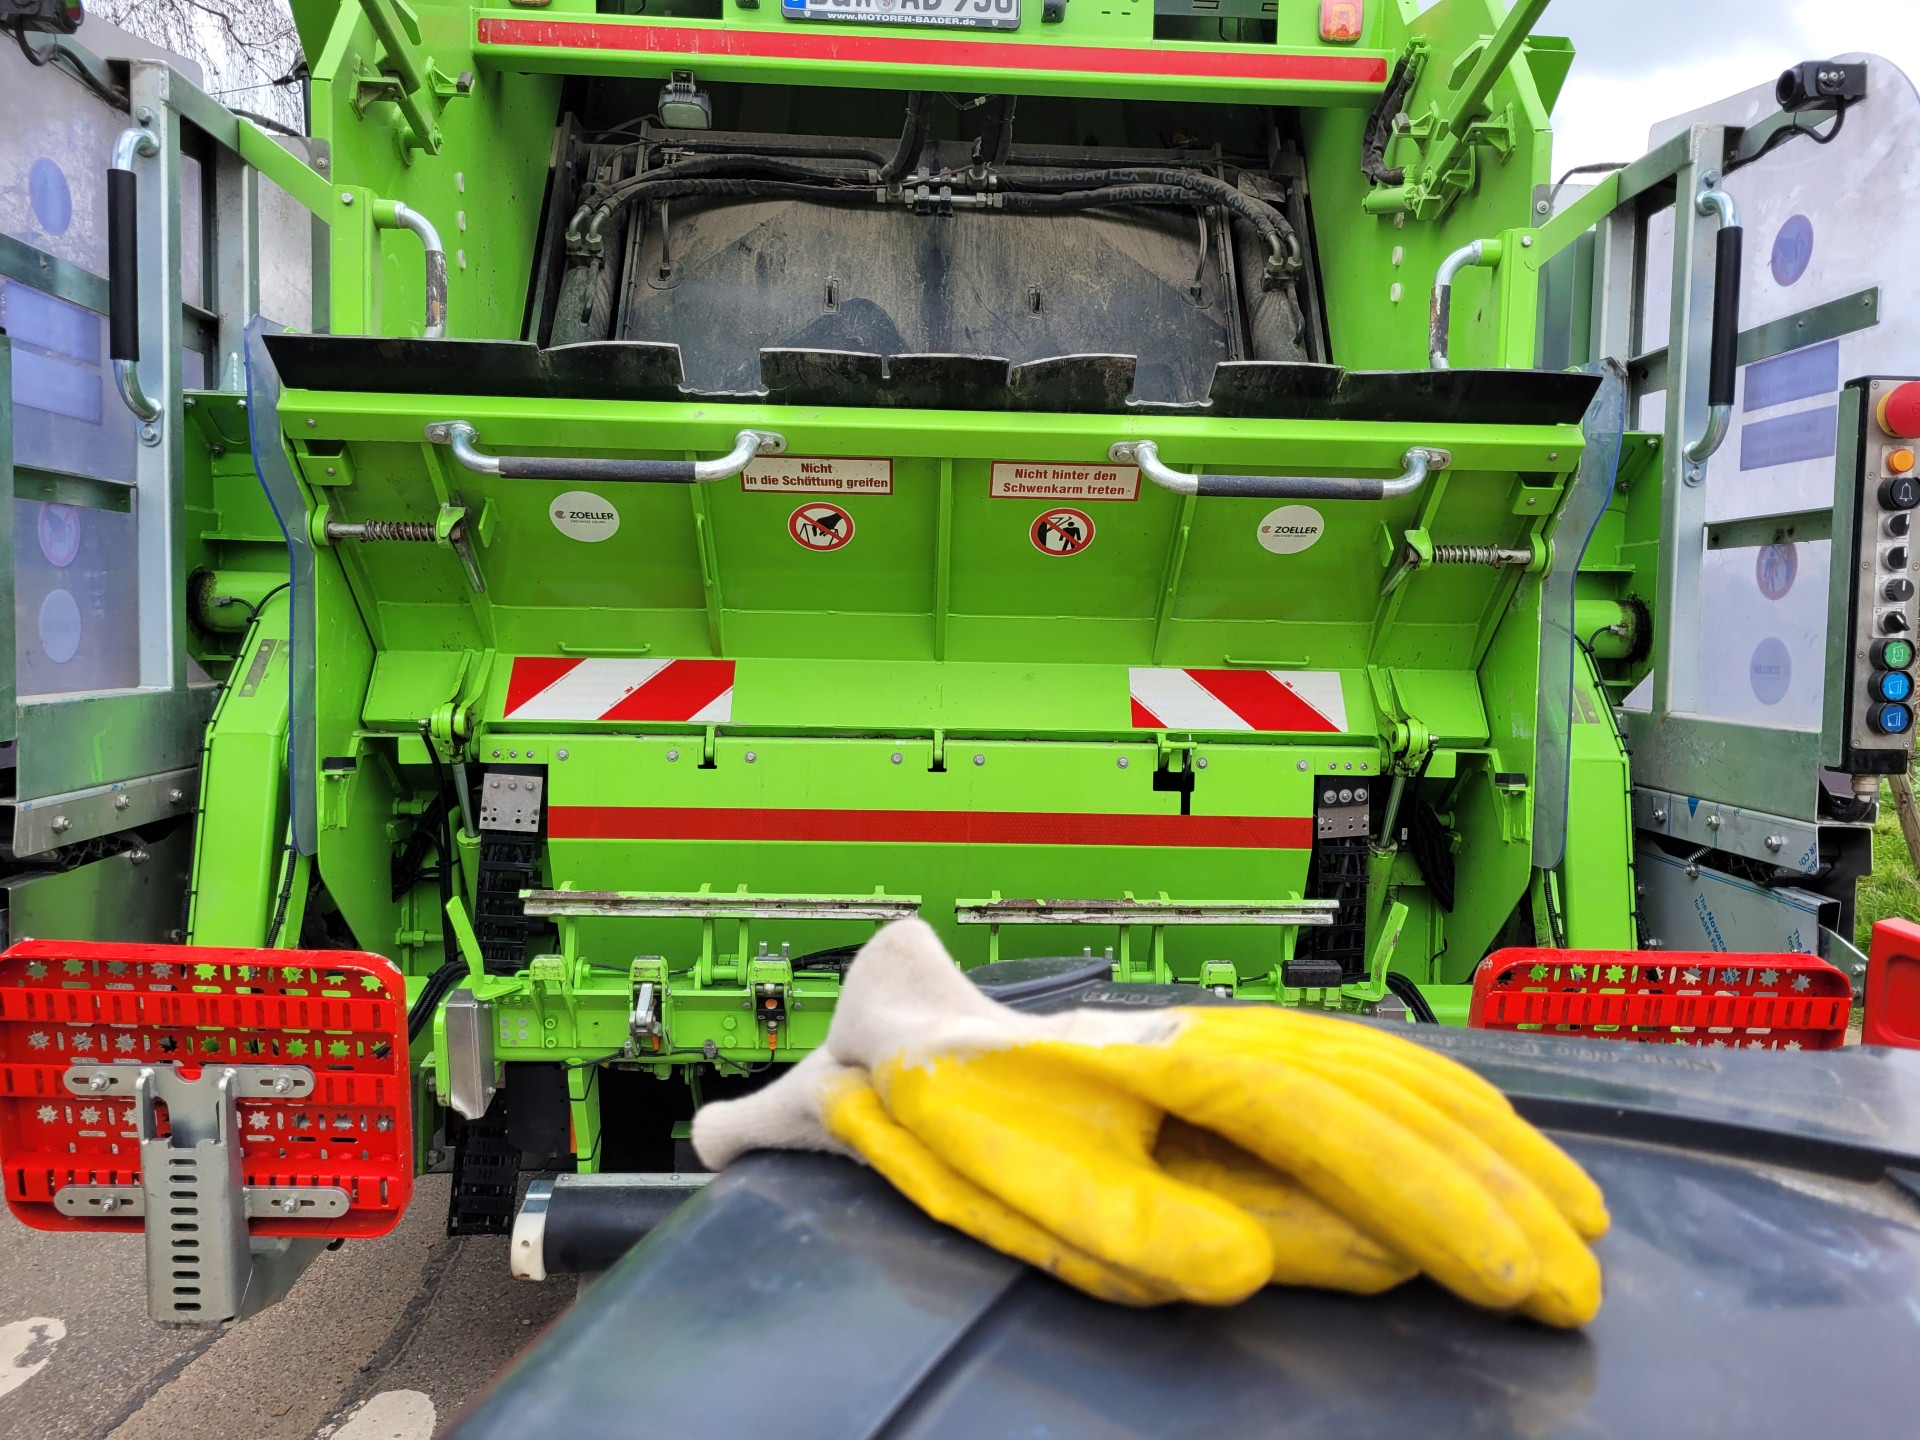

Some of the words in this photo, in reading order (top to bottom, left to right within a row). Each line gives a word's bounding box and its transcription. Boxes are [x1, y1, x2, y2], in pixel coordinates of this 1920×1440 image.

[827, 12, 976, 26] www.MOTOREN-BAADER.de
[1109, 185, 1203, 201] HANSA-FLE
[801, 463, 832, 473] Nicht
[1015, 469, 1048, 479] Nicht
[1052, 470, 1090, 480] hinter
[1094, 471, 1117, 480] den
[746, 475, 757, 484] in
[761, 475, 779, 485] die
[782, 475, 843, 488] Schüttung
[847, 477, 888, 488] greifen
[1003, 483, 1083, 493] Schwenkarm
[1087, 485, 1125, 495] treten
[569, 511, 614, 520] ZOELLER
[1274, 526, 1318, 534] ZOELLER
[1699, 892, 1707, 911] The
[1693, 898, 1701, 911] for
[1699, 911, 1712, 938] LASER
[1793, 927, 1803, 949] The
